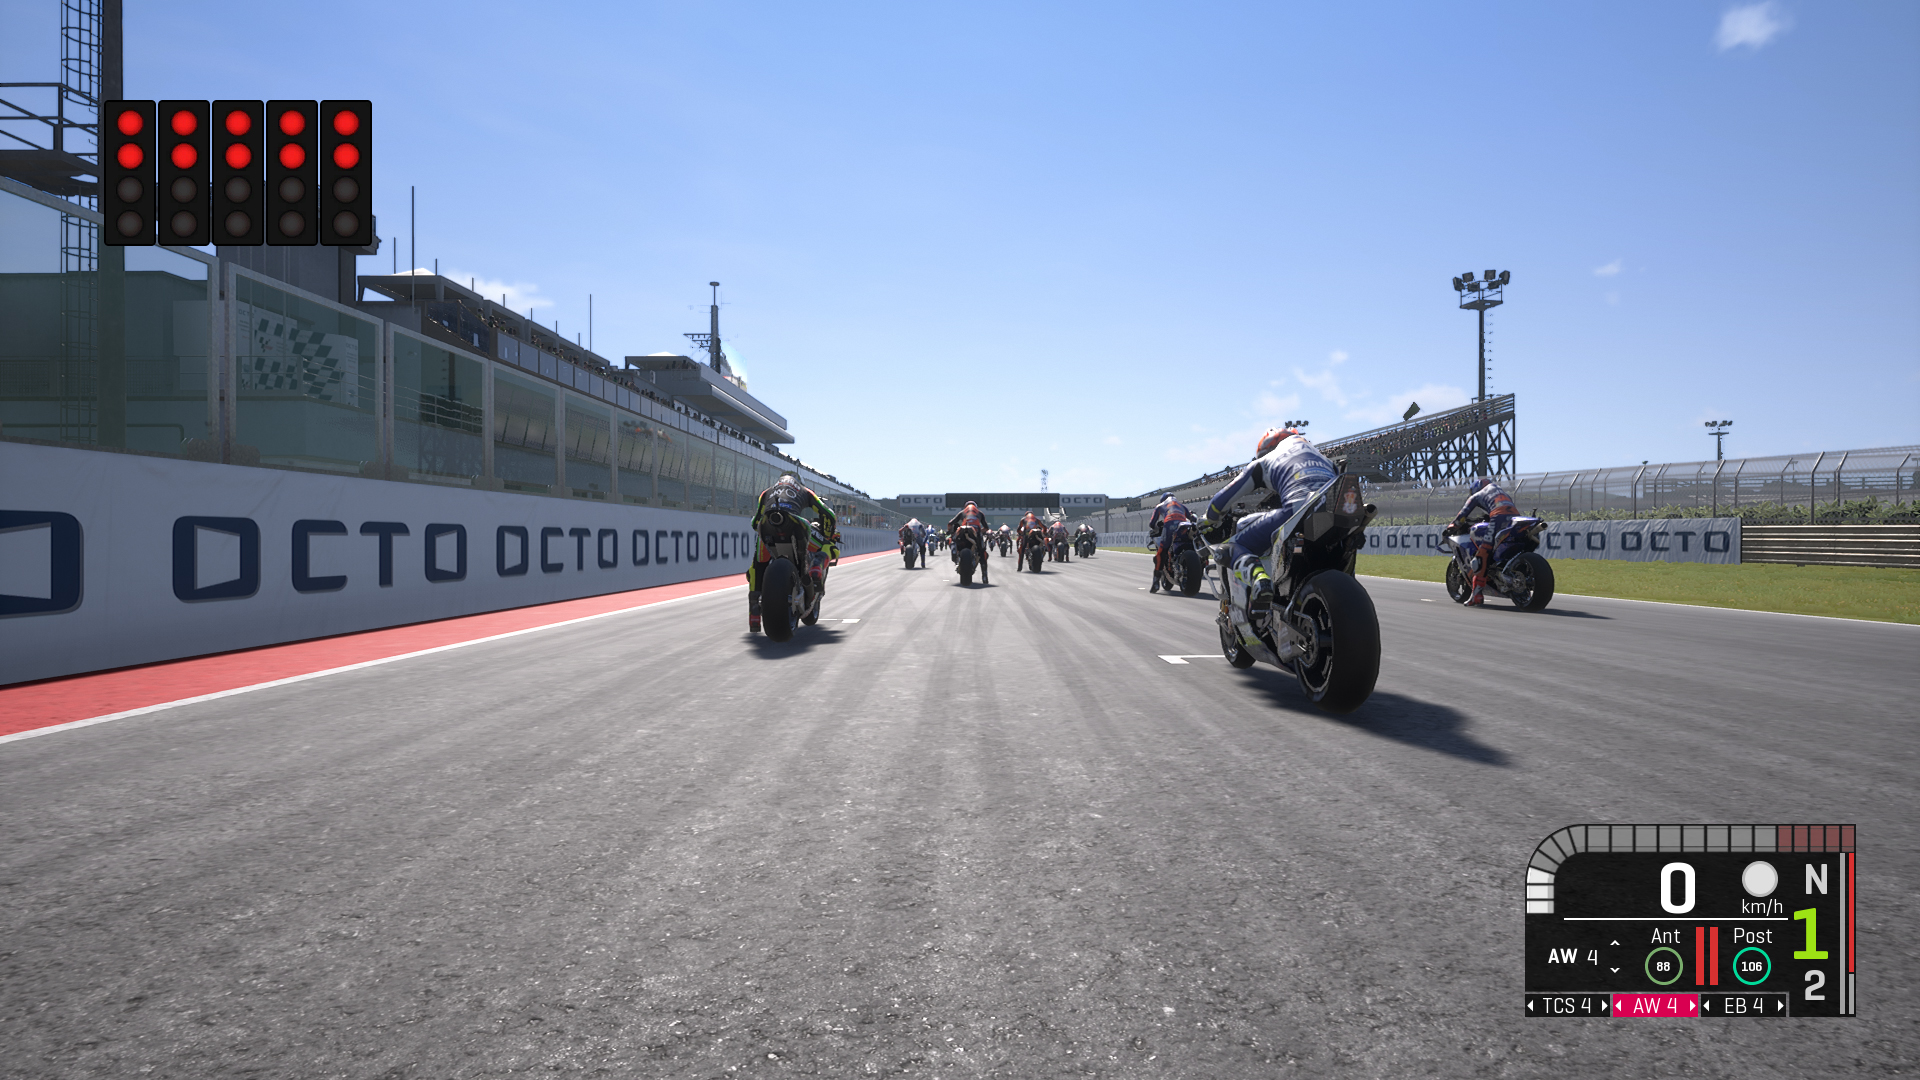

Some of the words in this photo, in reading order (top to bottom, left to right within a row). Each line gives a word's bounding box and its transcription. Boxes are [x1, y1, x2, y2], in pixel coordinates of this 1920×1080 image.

[1061, 496, 1103, 504] OCTO
[1387, 533, 1439, 549] OCTO
[1537, 531, 1606, 551] CTO
[1621, 531, 1730, 552] OCTO
[172, 515, 468, 603] OCTO
[496, 525, 618, 577] OCTO
[632, 529, 699, 567] OCTO
[707, 531, 750, 561] OCTO
